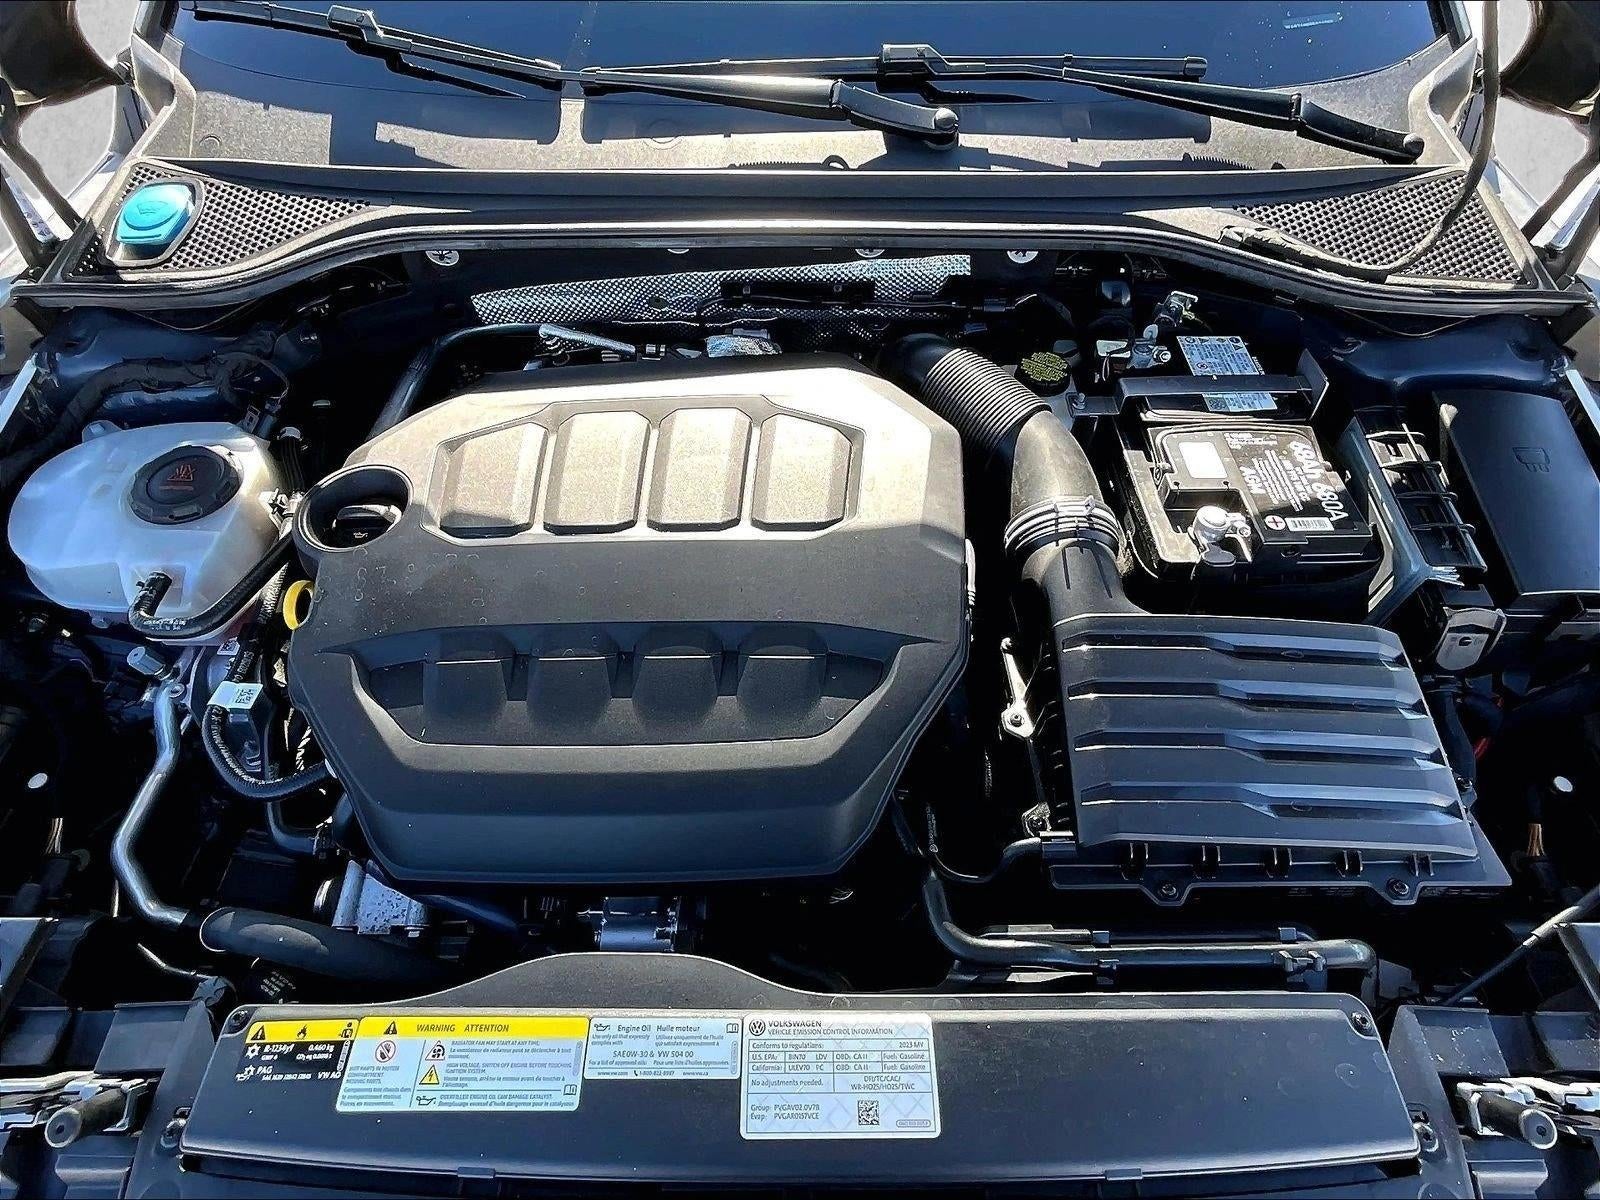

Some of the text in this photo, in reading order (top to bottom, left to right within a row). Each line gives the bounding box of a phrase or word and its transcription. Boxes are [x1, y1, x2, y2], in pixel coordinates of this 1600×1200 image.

[1239, 466, 1266, 494] AGM
[1311, 483, 1349, 522] 680A
[416, 1024, 456, 1033] WARNING
[464, 1024, 510, 1033] ATTENTION
[617, 1024, 652, 1034] Engine Oil
[656, 1024, 676, 1032] Huile
[768, 1020, 823, 1029] VOLKSWAGEN
[767, 1028, 894, 1036] VEHICLE EMISSION CONTROL INFORMATION
[751, 1042, 780, 1050] Conforms
[781, 1042, 788, 1050] to
[914, 1041, 924, 1049] MY
[649, 1050, 655, 1058] &
[657, 1050, 670, 1058] VW
[671, 1050, 684, 1058] 504
[684, 1050, 695, 1058] 00
[899, 1052, 925, 1060] Gasoline
[256, 1066, 273, 1075] PAG
[899, 1063, 926, 1071] Gasoline
[317, 1071, 330, 1080] VW
[751, 1078, 824, 1088] No adjustments needed.
